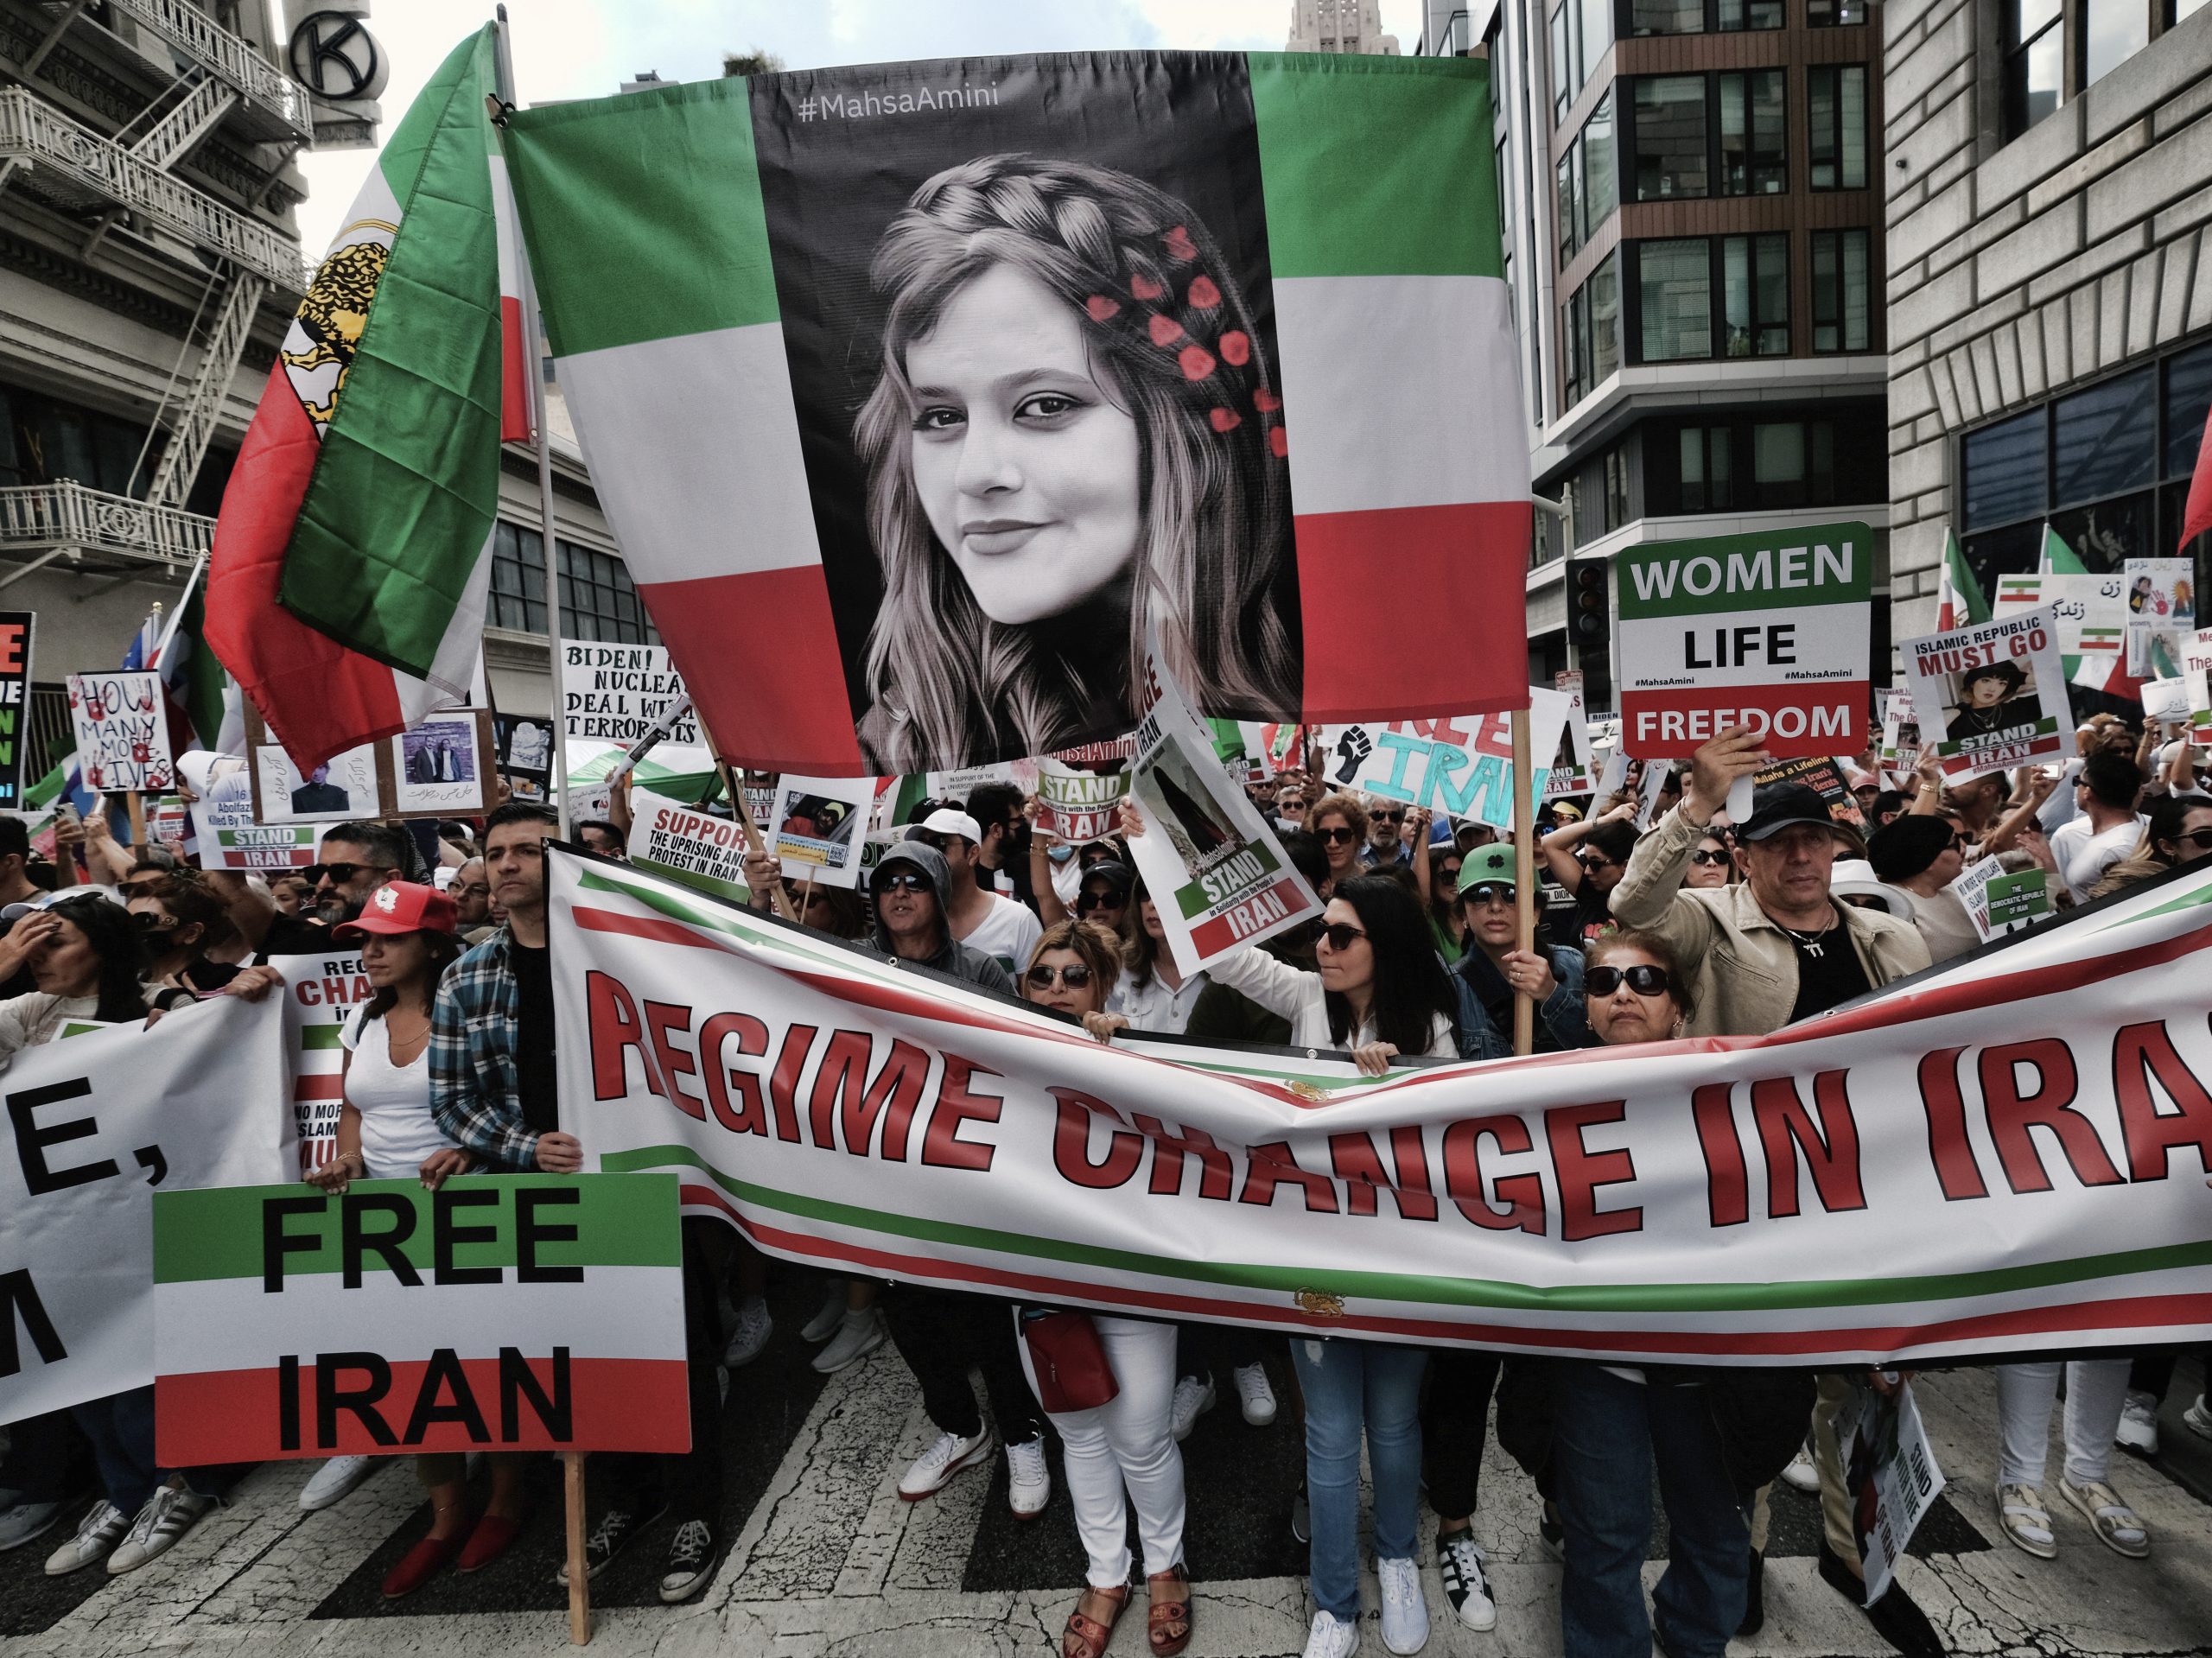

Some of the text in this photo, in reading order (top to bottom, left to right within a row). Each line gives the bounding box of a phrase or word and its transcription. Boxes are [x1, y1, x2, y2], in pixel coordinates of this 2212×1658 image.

[798, 81, 998, 123] #MahsaAmini
[1630, 542, 1853, 600] WOMEN
[2101, 580, 2120, 598] زن
[1685, 624, 1796, 670] LIFE
[1915, 617, 2040, 655] ISLAMIC REPUBLIC
[567, 646, 652, 670] BIDEN!
[1917, 629, 2047, 677] MUST GO
[594, 670, 687, 695] NUCLEA
[1635, 677, 1694, 687] #MahsaAmini
[1784, 669, 1853, 680] #MahsaAmini
[82, 678, 153, 716] HOW
[566, 692, 629, 716] DEAL
[81, 716, 156, 740] MANY
[566, 715, 696, 744] TERRORTS
[1637, 704, 1851, 741] FREEDOM
[1889, 712, 1905, 722] The
[1960, 723, 2037, 751] STAND
[1787, 766, 1794, 775] a
[1794, 755, 1830, 772] Lifeline
[1970, 743, 2031, 766] IRAN
[1973, 759, 2024, 775] #MahsaAmini
[94, 759, 172, 789] LIVES
[1544, 781, 1572, 793] RAN
[1045, 776, 1122, 803] STAND
[233, 829, 296, 845] STAND
[654, 809, 753, 852] SUPPOR
[1052, 810, 1111, 839] IRAN
[244, 850, 291, 866] IRAN
[650, 830, 668, 848] THE
[671, 835, 722, 861] UPRISING
[648, 846, 740, 882] PROTEST IN IRAN
[1200, 849, 1265, 903] STAND
[1990, 890, 2045, 909] DEMOCRATIC REPUBLIC
[2012, 885, 2022, 893] THE
[1216, 898, 1240, 915] Solidarity
[1224, 889, 1289, 940] IRAN
[586, 969, 2212, 1242] REGIME CHANGE IN IRA
[263, 1187, 584, 1293] FREE
[279, 1346, 573, 1452] IRAN
[1910, 1442, 1932, 1497] STAND
[1904, 1484, 1921, 1523] THE
[1880, 1525, 1897, 1570] IRAN
